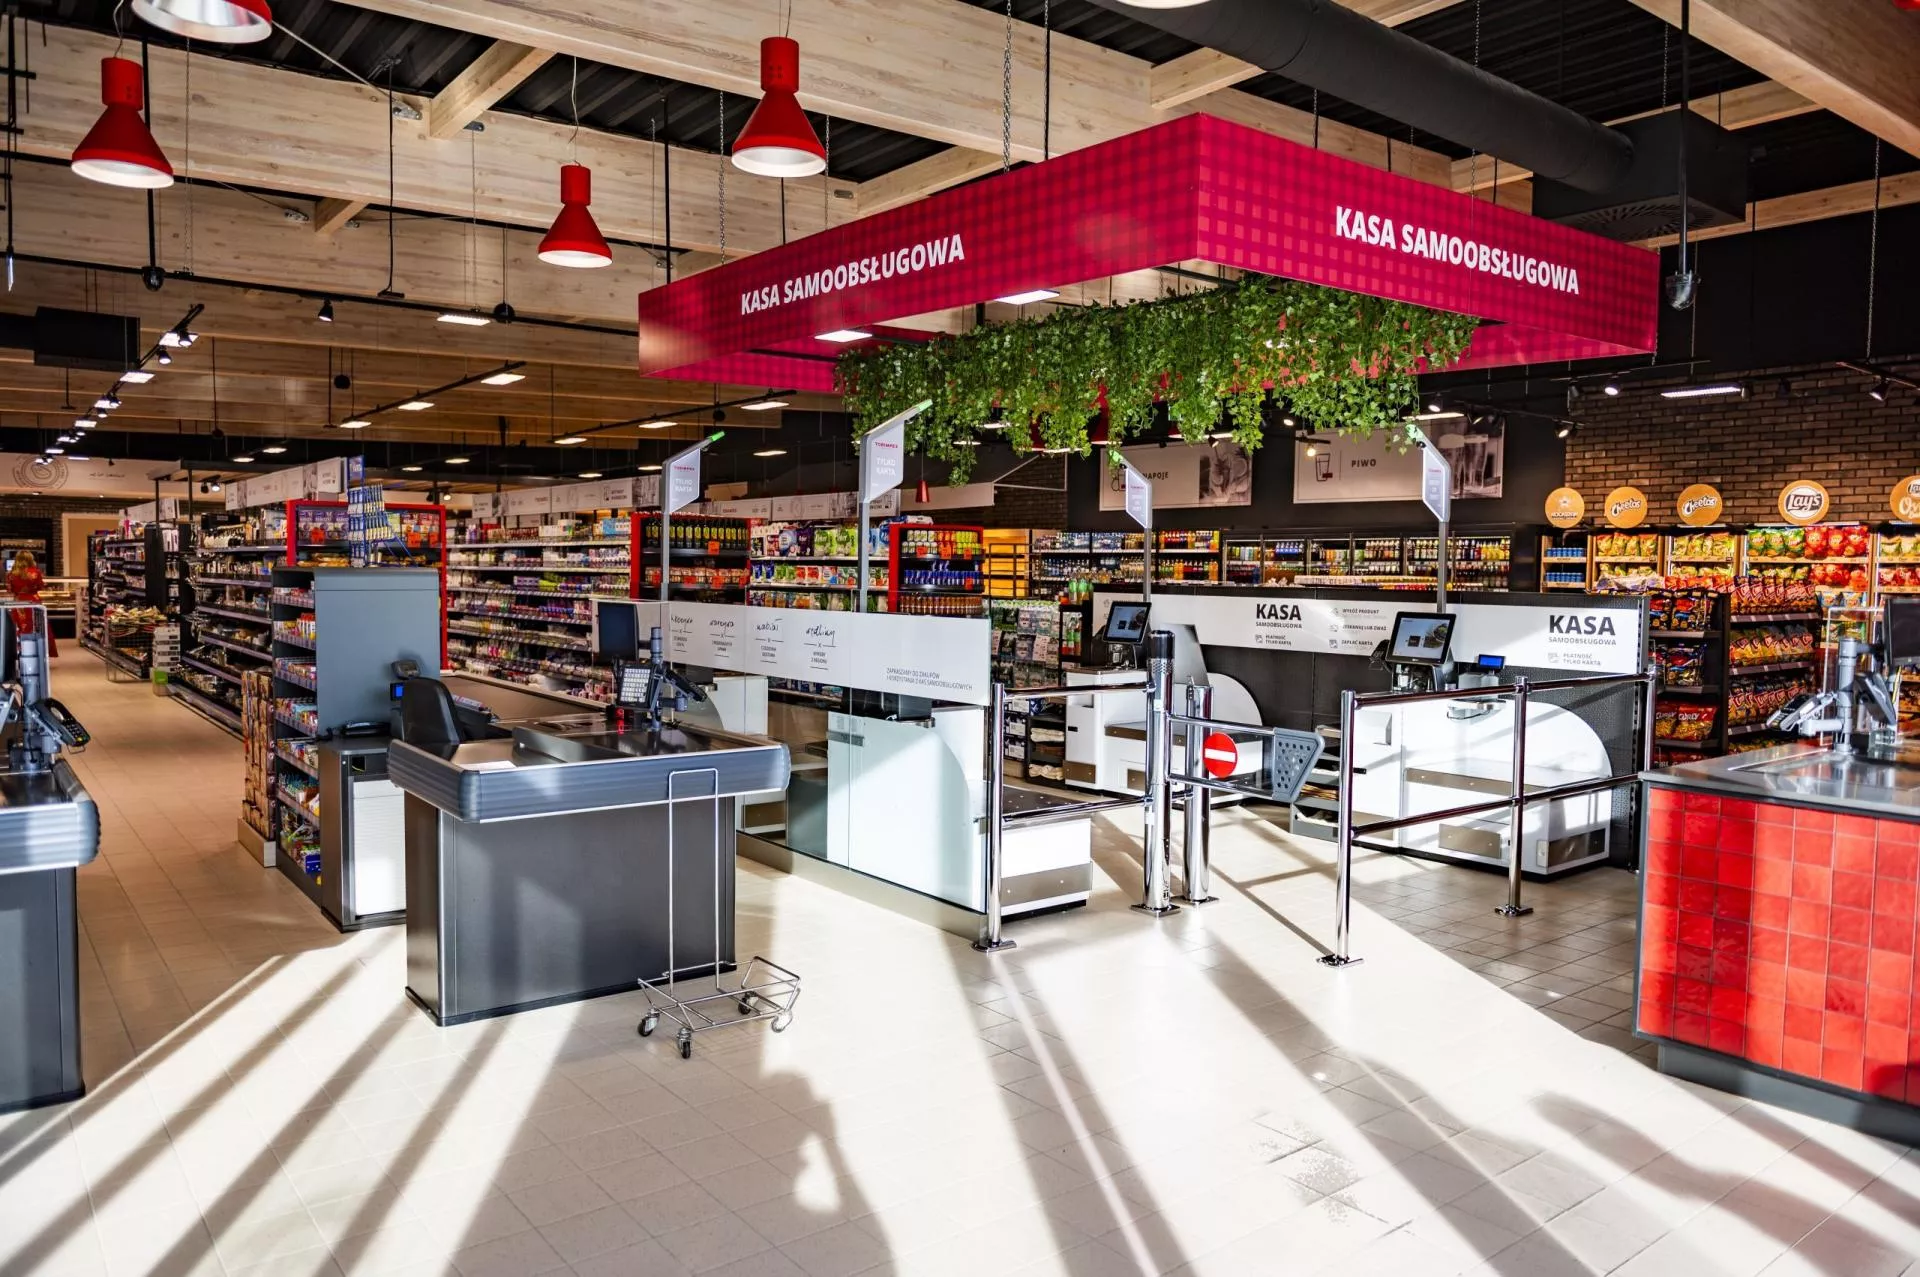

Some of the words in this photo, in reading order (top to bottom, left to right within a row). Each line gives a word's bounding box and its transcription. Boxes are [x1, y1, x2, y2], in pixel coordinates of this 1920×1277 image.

[1336, 206, 1396, 250] KASA
[1401, 224, 1580, 295] SAMOOBSŁUGOWA
[741, 284, 780, 315] KASA
[783, 234, 965, 304] SAMOOBSŁUGOWA
[876, 457, 896, 466] TYLKO
[1351, 459, 1376, 468] PIWO
[1142, 472, 1168, 480] NAPOJE
[1611, 498, 1642, 517] Cheetos
[1682, 495, 1717, 518] Cheetos
[1256, 604, 1302, 620] KASA
[1549, 615, 1616, 635] KASA
[1548, 637, 1616, 645] SAMOOBSŁUGOWA
[886, 667, 911, 675] ZAPRASZAMY
[919, 671, 940, 679] ZAKUPÓW
[889, 676, 914, 684] KORZYSTANIA
[926, 680, 972, 690] SAMOOBSŁUGOWYCH
